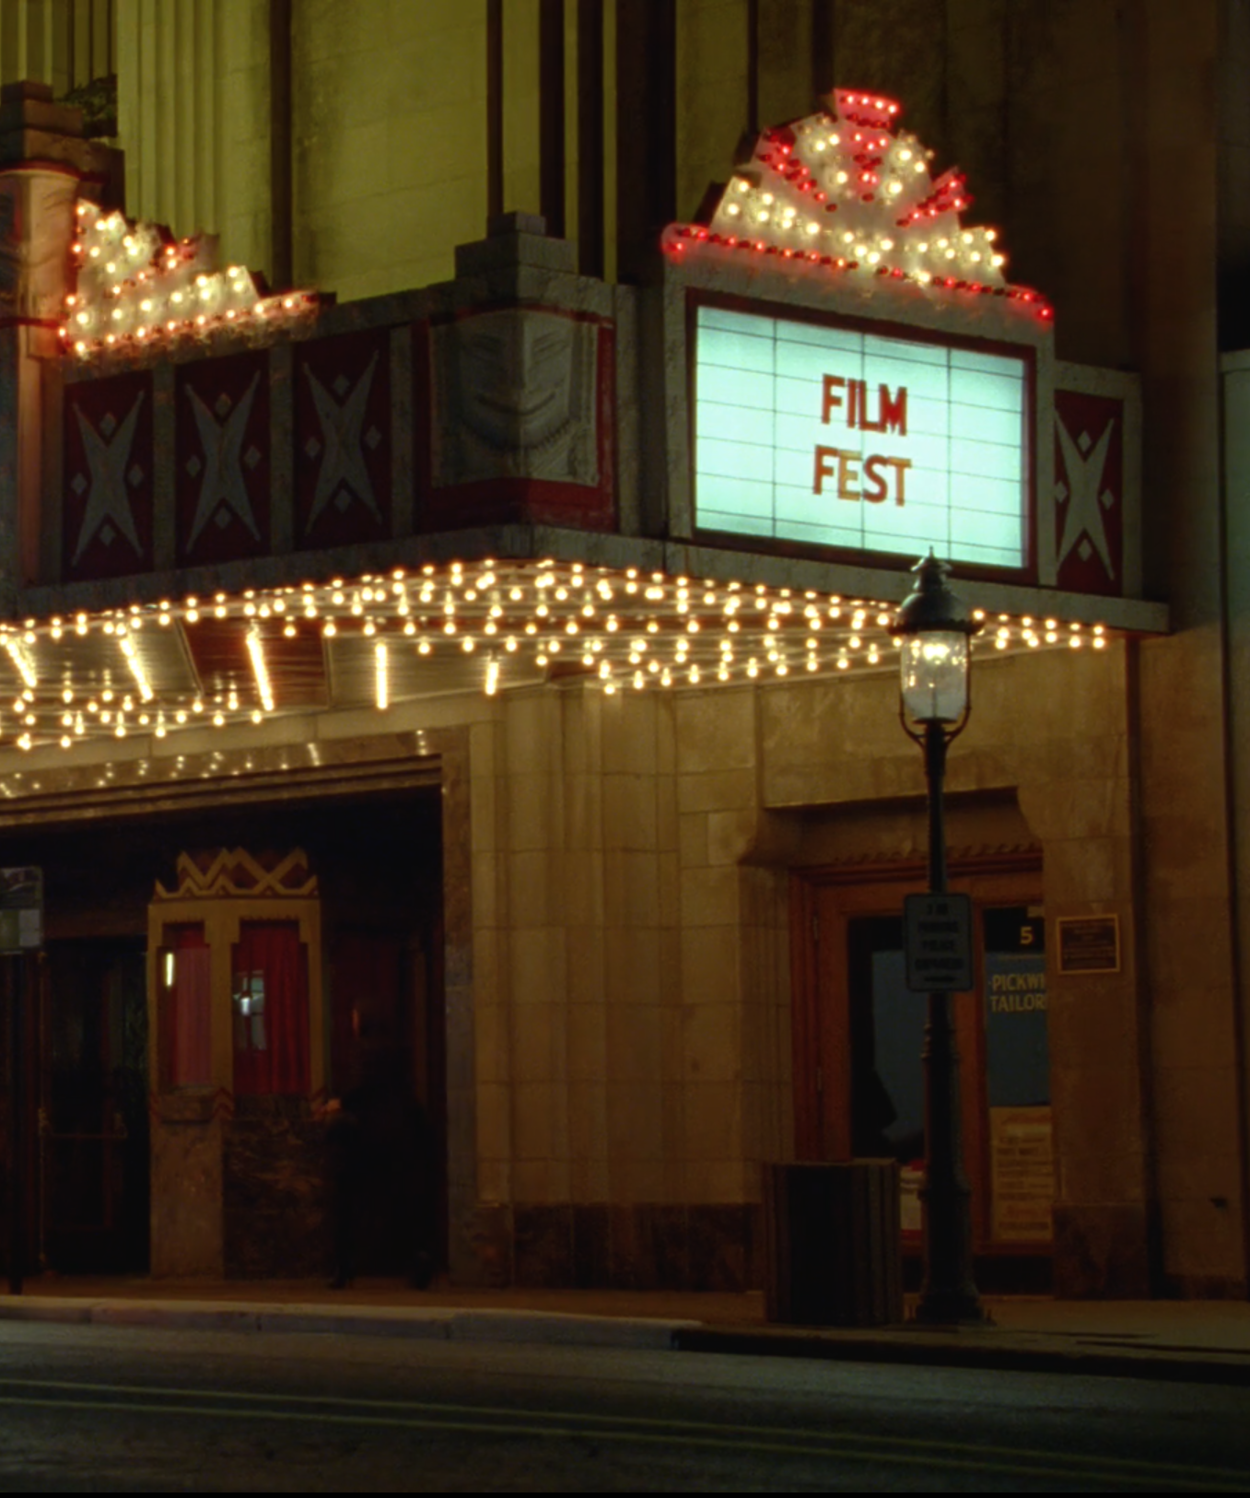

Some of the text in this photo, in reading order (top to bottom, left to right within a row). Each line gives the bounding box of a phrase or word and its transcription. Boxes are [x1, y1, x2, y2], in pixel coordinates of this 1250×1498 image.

[821, 372, 908, 437] FILM
[812, 443, 912, 507] FEST
[1019, 925, 1034, 945] 5
[991, 973, 1045, 992] PICKWI
